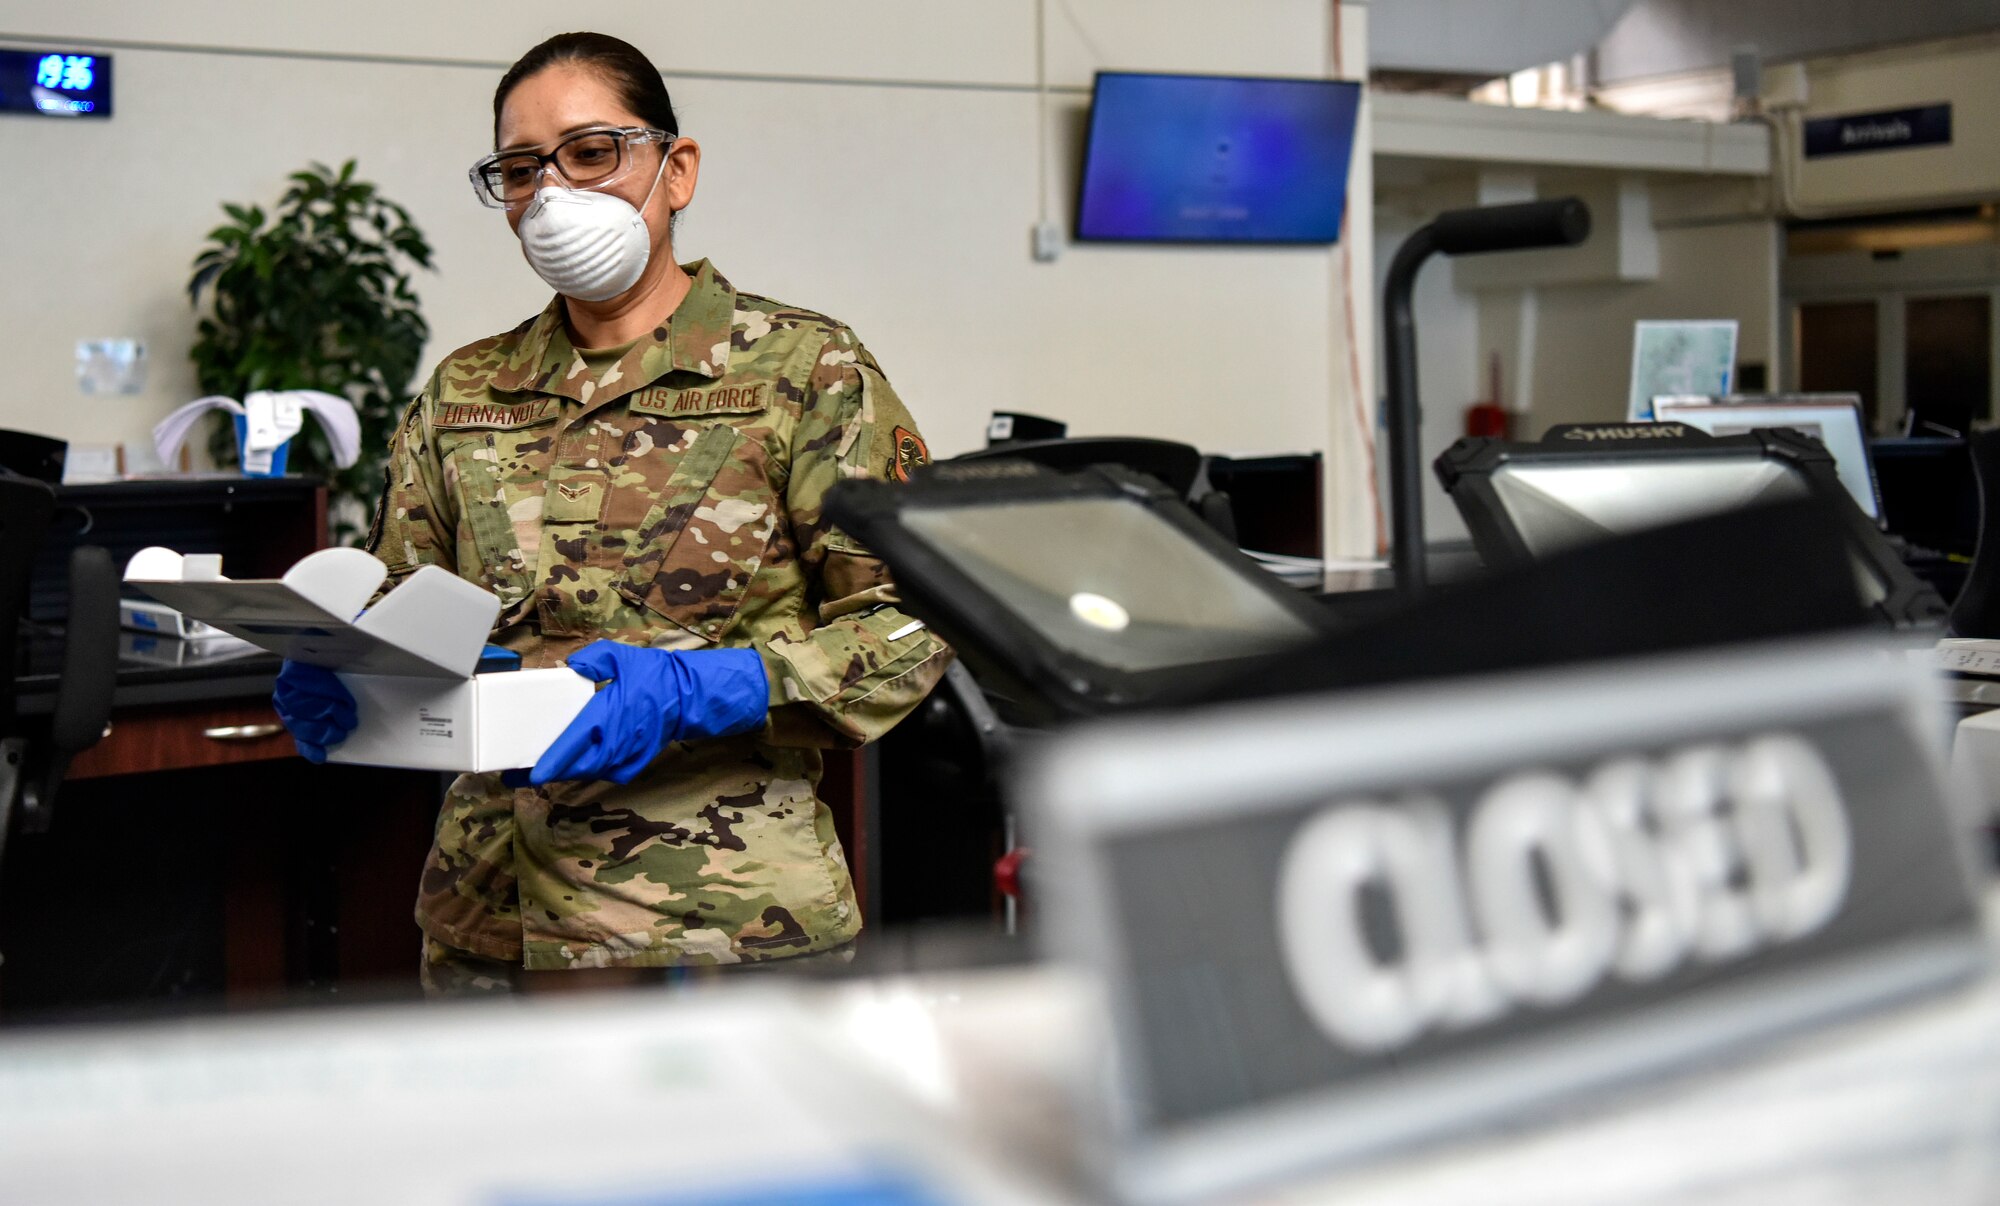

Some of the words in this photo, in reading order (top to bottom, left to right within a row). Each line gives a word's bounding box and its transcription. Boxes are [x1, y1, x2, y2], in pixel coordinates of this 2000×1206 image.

[1841, 119, 1911, 144] Arrivals
[443, 399, 550, 425] HERNANDEZ
[639, 388, 668, 410] U.S.
[672, 391, 703, 412] AIR
[706, 386, 760, 410] FORCE
[1596, 425, 1685, 440] HUSKY
[1276, 731, 1854, 1056] CLOSED
